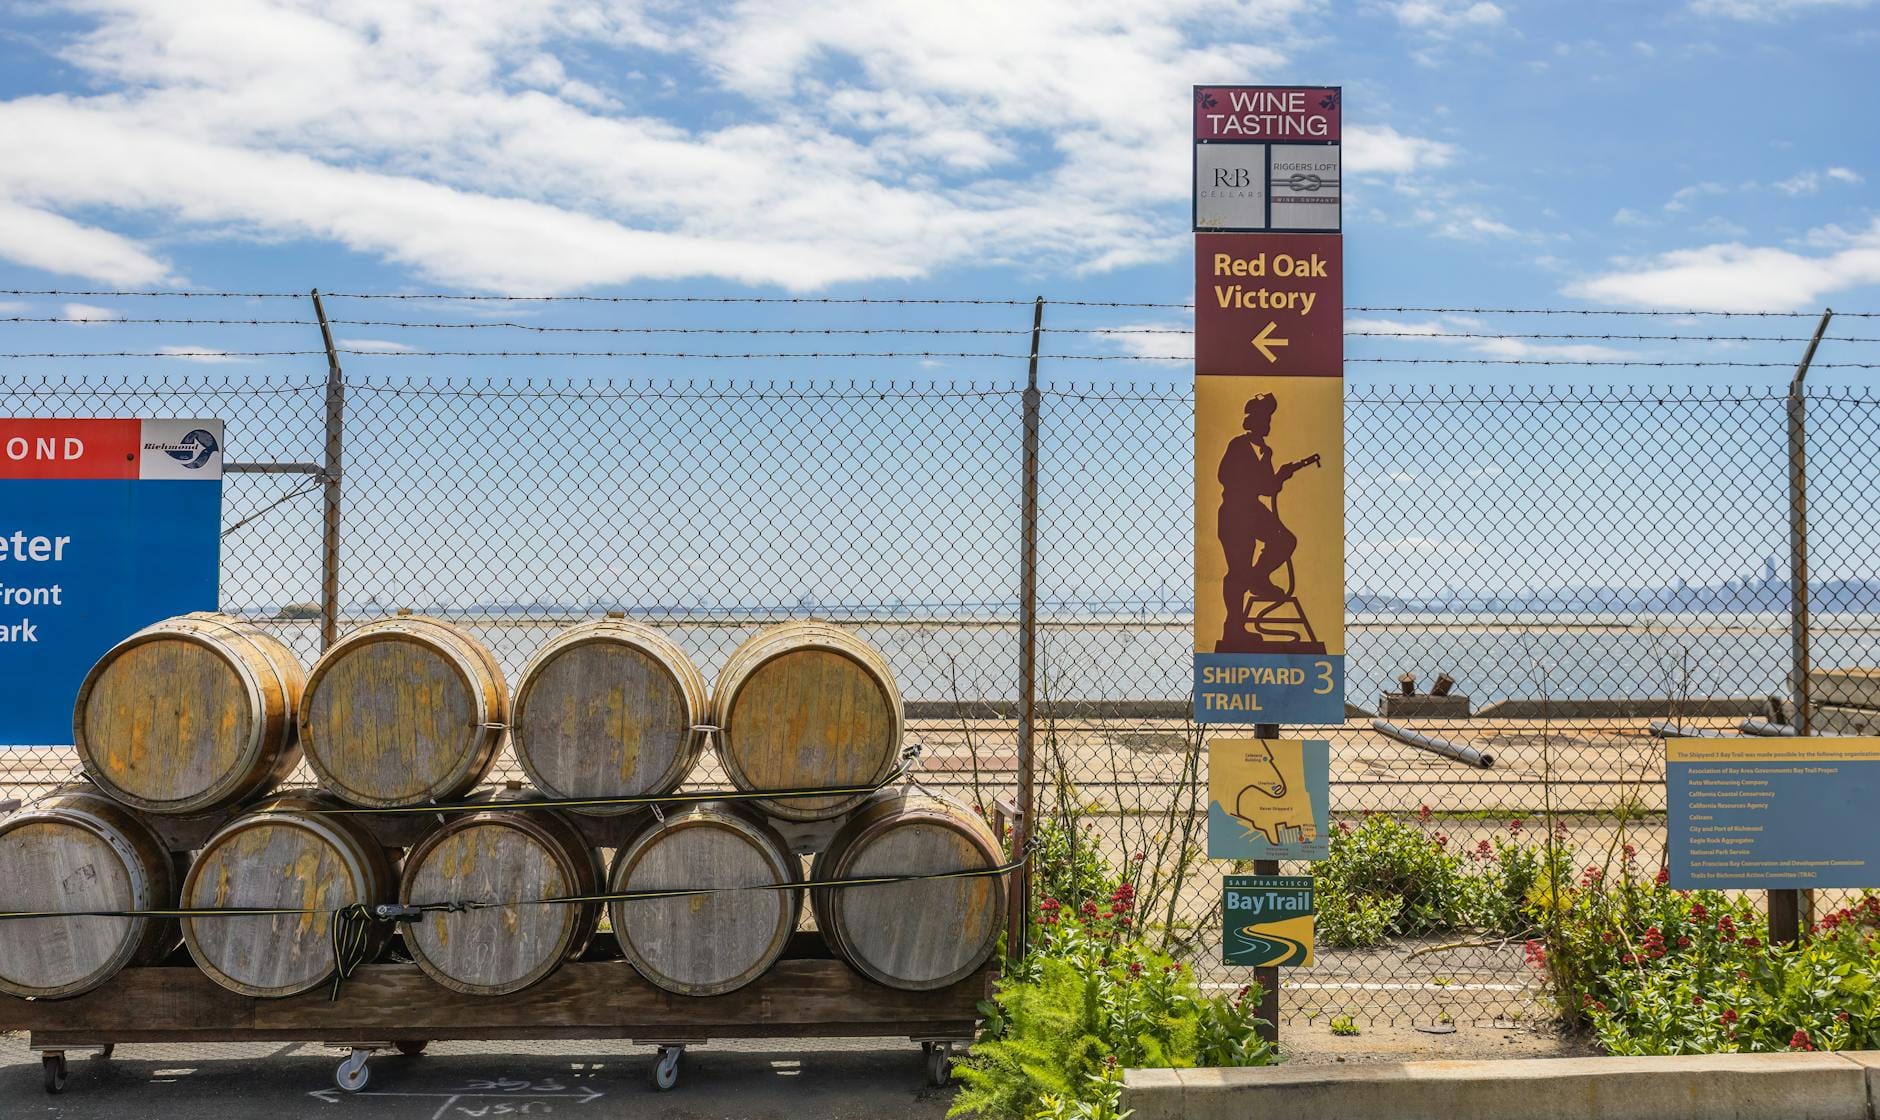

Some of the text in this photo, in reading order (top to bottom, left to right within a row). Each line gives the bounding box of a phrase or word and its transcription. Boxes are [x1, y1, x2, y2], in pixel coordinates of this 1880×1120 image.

[1230, 92, 1306, 113] WINE
[1206, 114, 1328, 136] TASTING
[1273, 163, 1338, 171] RIGGERS LOFT
[1200, 190, 1263, 198] CELLARS
[1213, 253, 1328, 278] Red Oak
[1213, 285, 1317, 316] Victory
[6, 437, 84, 461] OND
[143, 442, 199, 451] Richmond
[0, 583, 63, 605] ront
[1202, 660, 1335, 695] SHIPYARD 3
[1202, 692, 1264, 711] TRAIL
